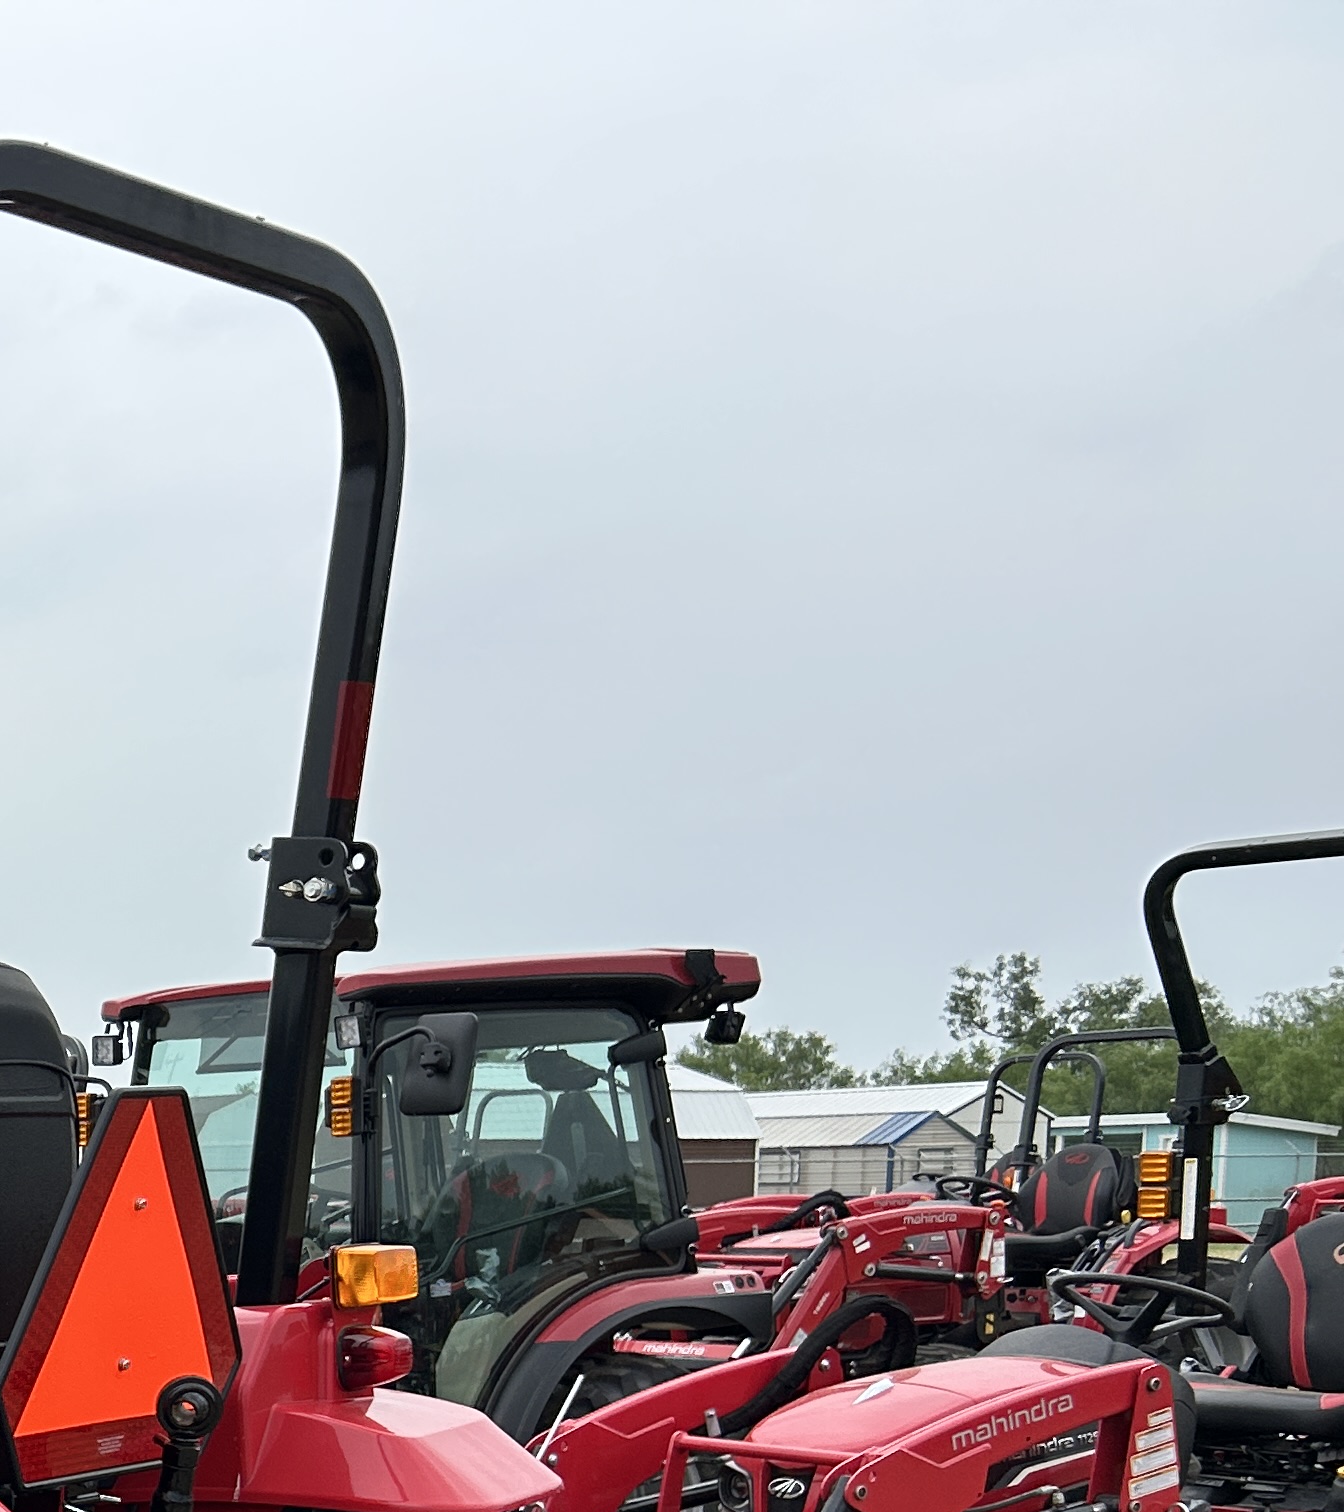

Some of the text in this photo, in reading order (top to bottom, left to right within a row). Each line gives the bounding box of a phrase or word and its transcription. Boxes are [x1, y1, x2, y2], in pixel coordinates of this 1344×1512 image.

[902, 1212, 958, 1225] mahindra
[641, 1343, 706, 1356] mahindra
[951, 1394, 1074, 1451] mahindra
